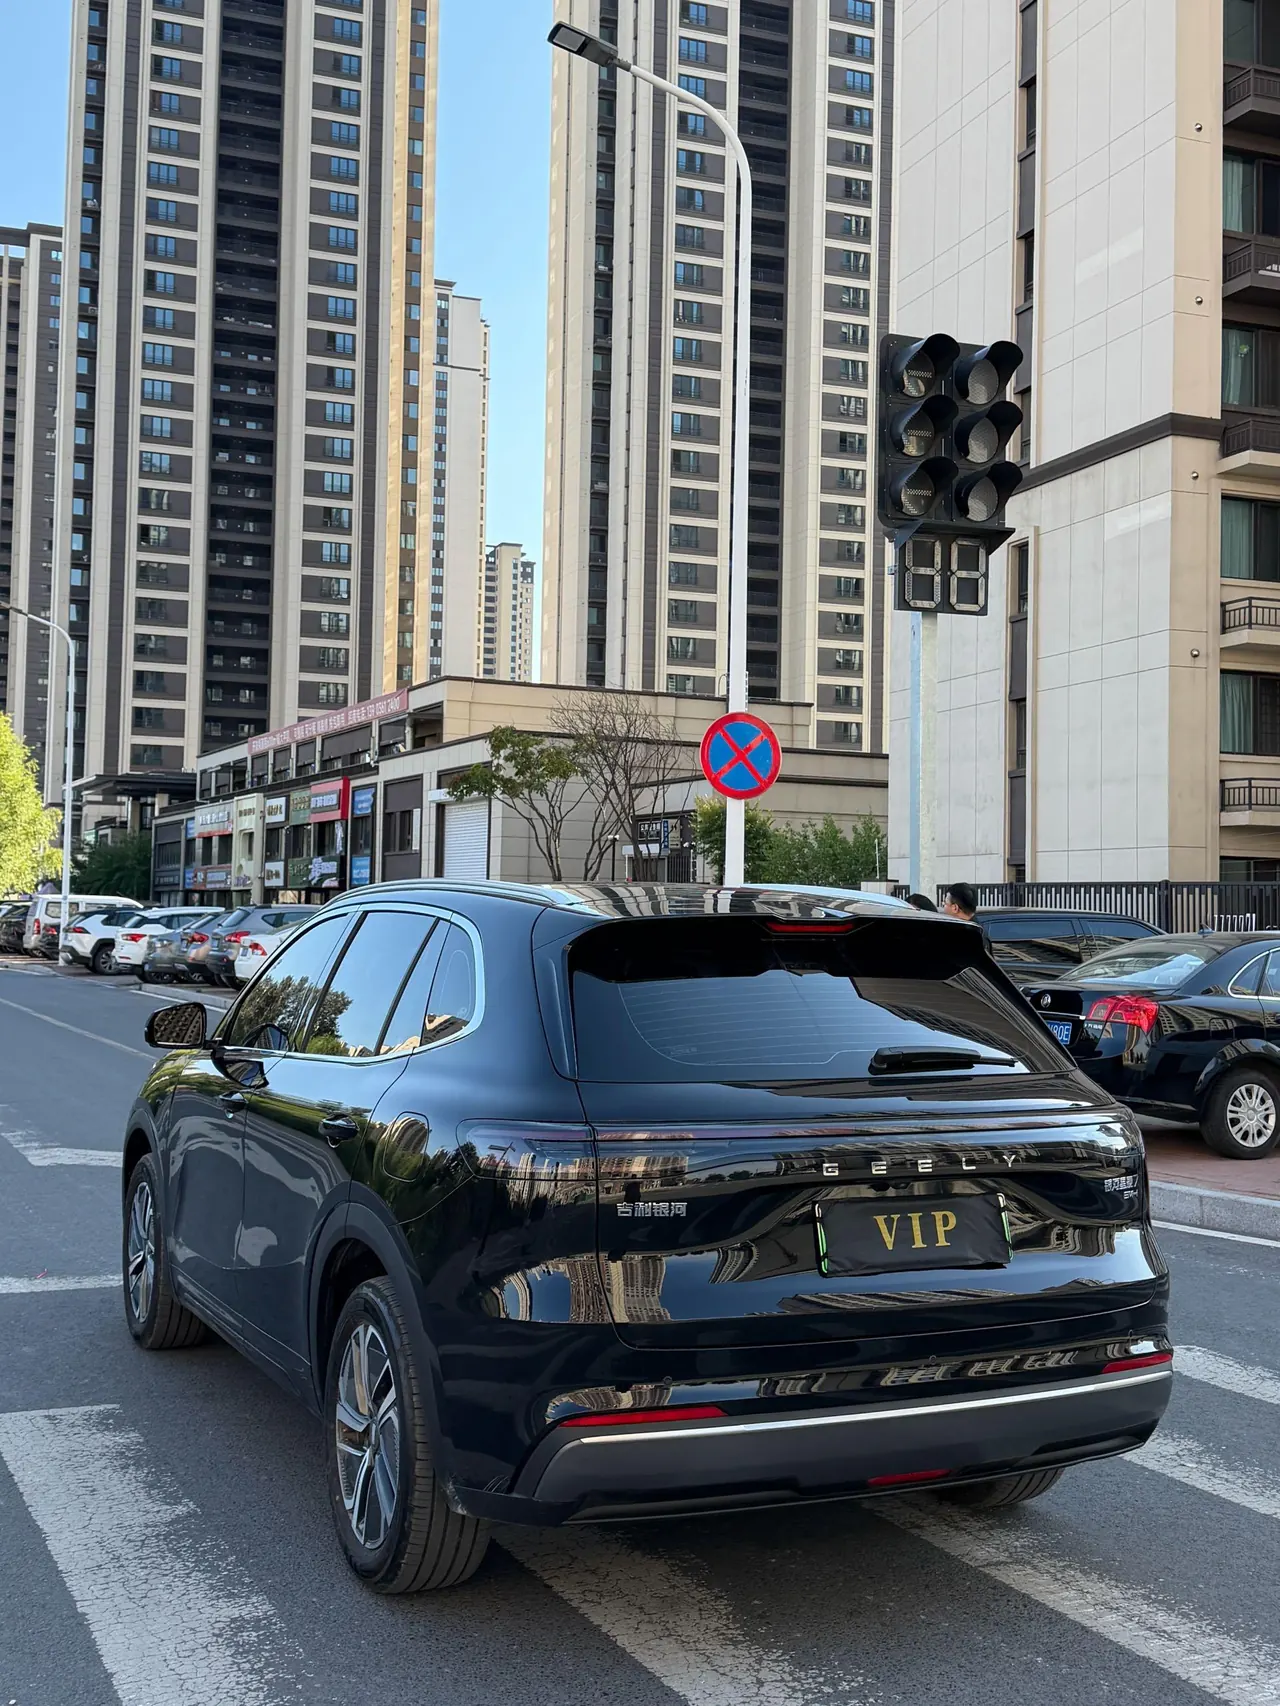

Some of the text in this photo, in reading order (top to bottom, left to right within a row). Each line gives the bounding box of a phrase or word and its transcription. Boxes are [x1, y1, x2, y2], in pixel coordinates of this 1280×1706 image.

[822, 1154, 1016, 1177] GEELY
[616, 1201, 688, 1217] 吉利银河
[873, 1210, 957, 1251] VIP
